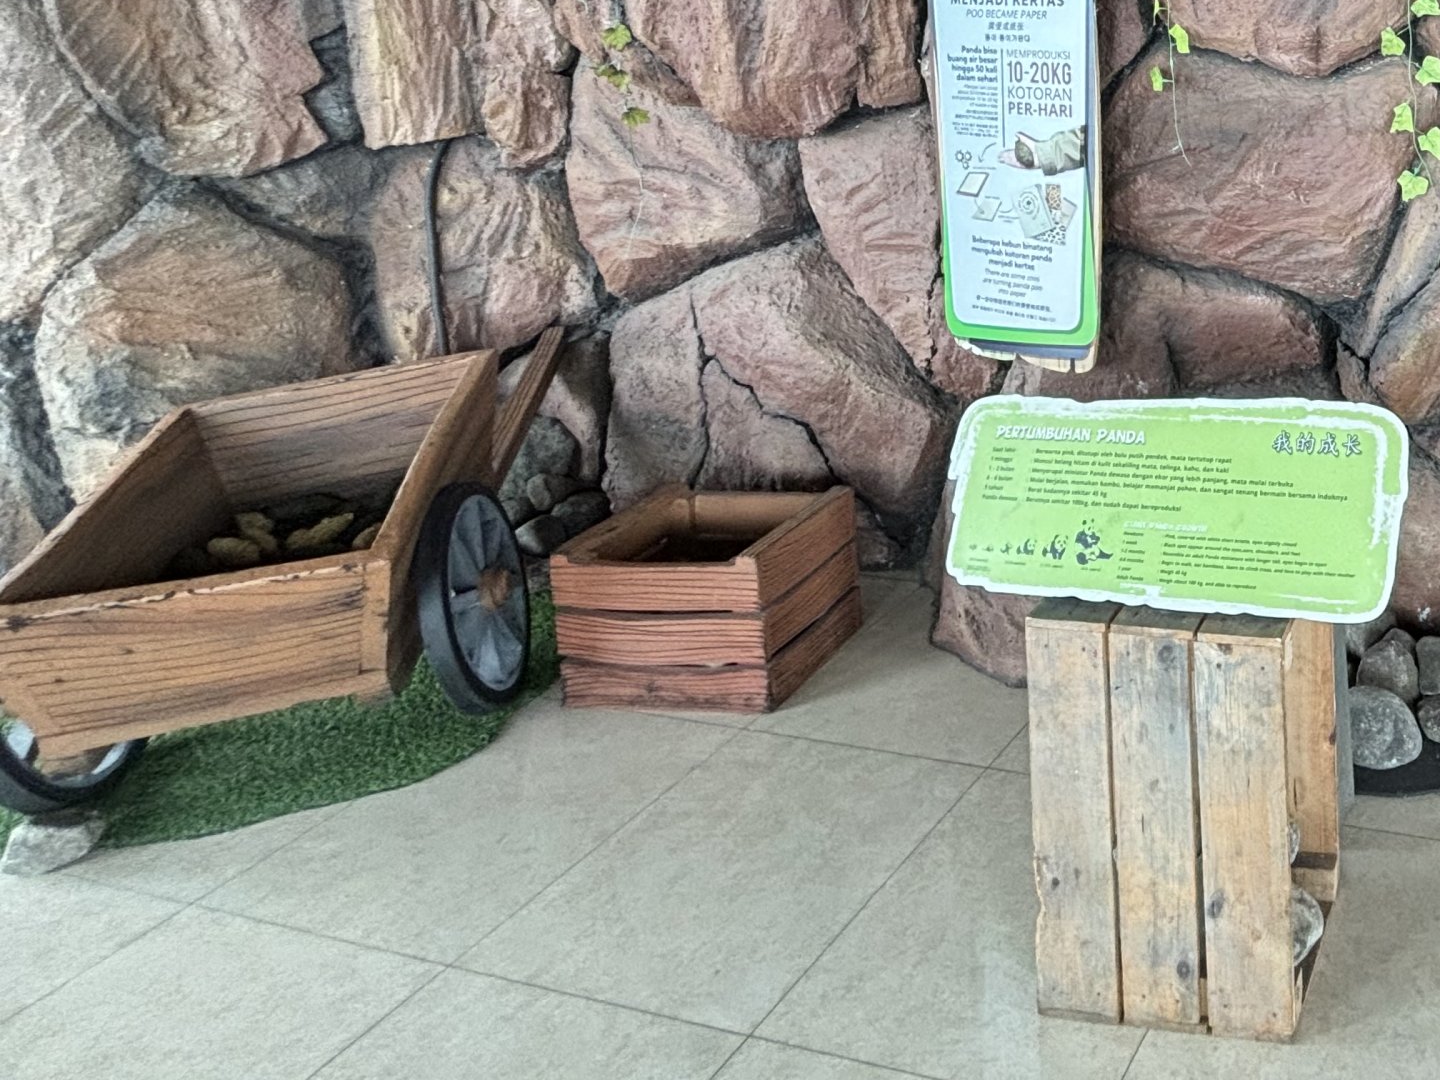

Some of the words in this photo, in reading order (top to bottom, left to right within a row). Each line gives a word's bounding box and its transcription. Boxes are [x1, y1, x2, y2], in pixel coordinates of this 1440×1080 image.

[966, 9, 984, 18] POO
[986, 9, 1018, 19] BECAME
[1020, 10, 1047, 19] PAPER
[961, 45, 982, 54] Panda
[1006, 49, 1071, 60] MEMPRODUKSI
[947, 53, 967, 64] buang
[976, 65, 984, 73] 50
[1007, 61, 1071, 85] 10-20KG
[1008, 86, 1072, 101] KOTORAN
[1008, 102, 1073, 118] PER-HARI
[995, 425, 1091, 442] PERTUMBUHAN
[1096, 428, 1146, 445] PANDA
[1271, 429, 1363, 458] 我的成长
